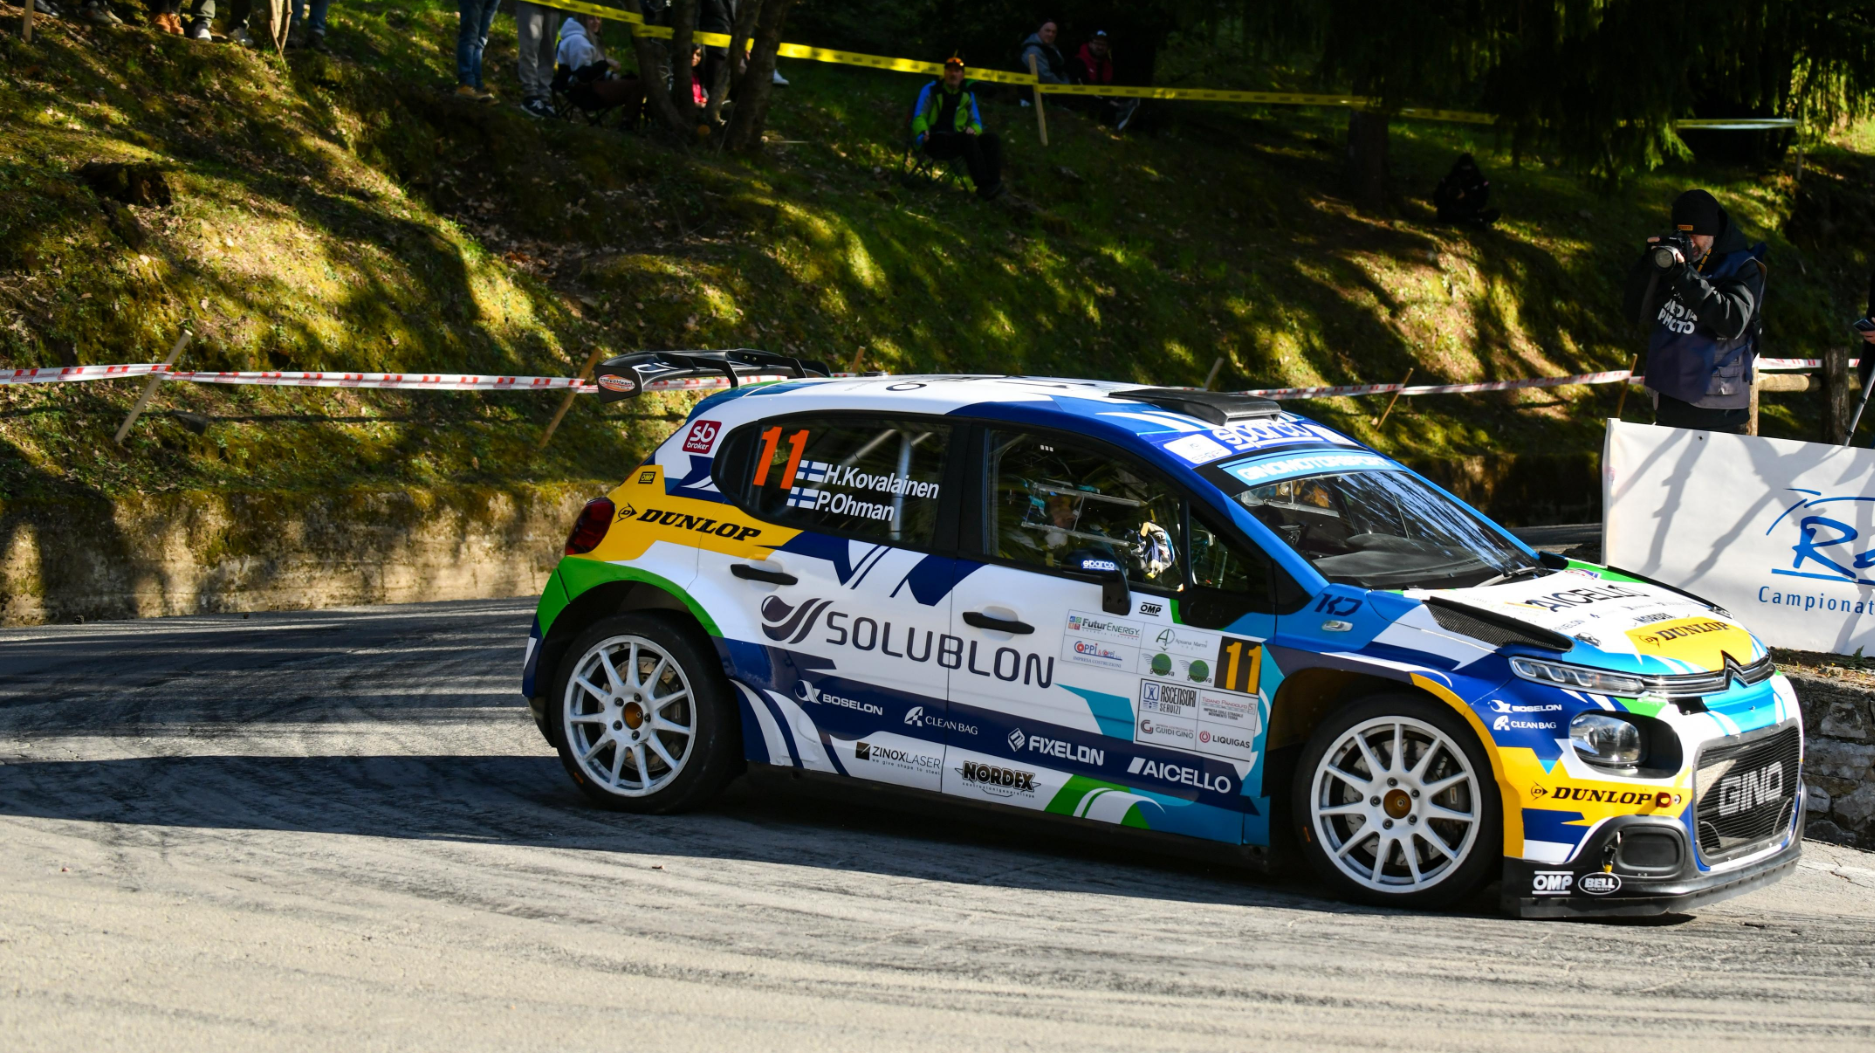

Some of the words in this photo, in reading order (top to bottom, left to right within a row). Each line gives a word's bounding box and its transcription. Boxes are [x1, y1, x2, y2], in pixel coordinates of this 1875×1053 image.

[1657, 308, 1696, 335] PHOTO
[686, 441, 709, 450] broker
[753, 426, 810, 491] 11
[823, 462, 939, 500] H.Kovalainen
[815, 490, 895, 523] P.Ohman
[636, 508, 762, 542] DUNLOP
[1140, 604, 1162, 615] OMP
[1654, 621, 1731, 641] DUNLOP
[826, 611, 1055, 689] SOLUBLON
[1149, 667, 1175, 677] geonova
[1225, 641, 1262, 694] 11
[1186, 674, 1212, 684] geonova
[822, 693, 883, 716] BOSELON
[1160, 685, 1197, 708] ASCENSORI
[1159, 703, 1182, 715] SERVIZI
[1512, 703, 1562, 713] BOSELON
[925, 715, 958, 731] CLEAN
[958, 723, 979, 736] BAG
[1155, 726, 1175, 736] GUIDI
[1175, 730, 1194, 740] GINO
[1510, 720, 1538, 730] CLEAN
[1538, 721, 1557, 730] BAG
[1028, 735, 1105, 767] FIXELON
[1212, 735, 1250, 749] LIQUIGAS
[872, 745, 941, 770] ZINOXLASER
[897, 763, 914, 771] shape
[962, 760, 1036, 793] NORDEX
[1142, 760, 1232, 795] AICELLO
[1551, 786, 1653, 806] DUNLOP
[1718, 760, 1784, 818] GINO
[1532, 875, 1574, 891] OMP
[1584, 877, 1616, 888] BELL
